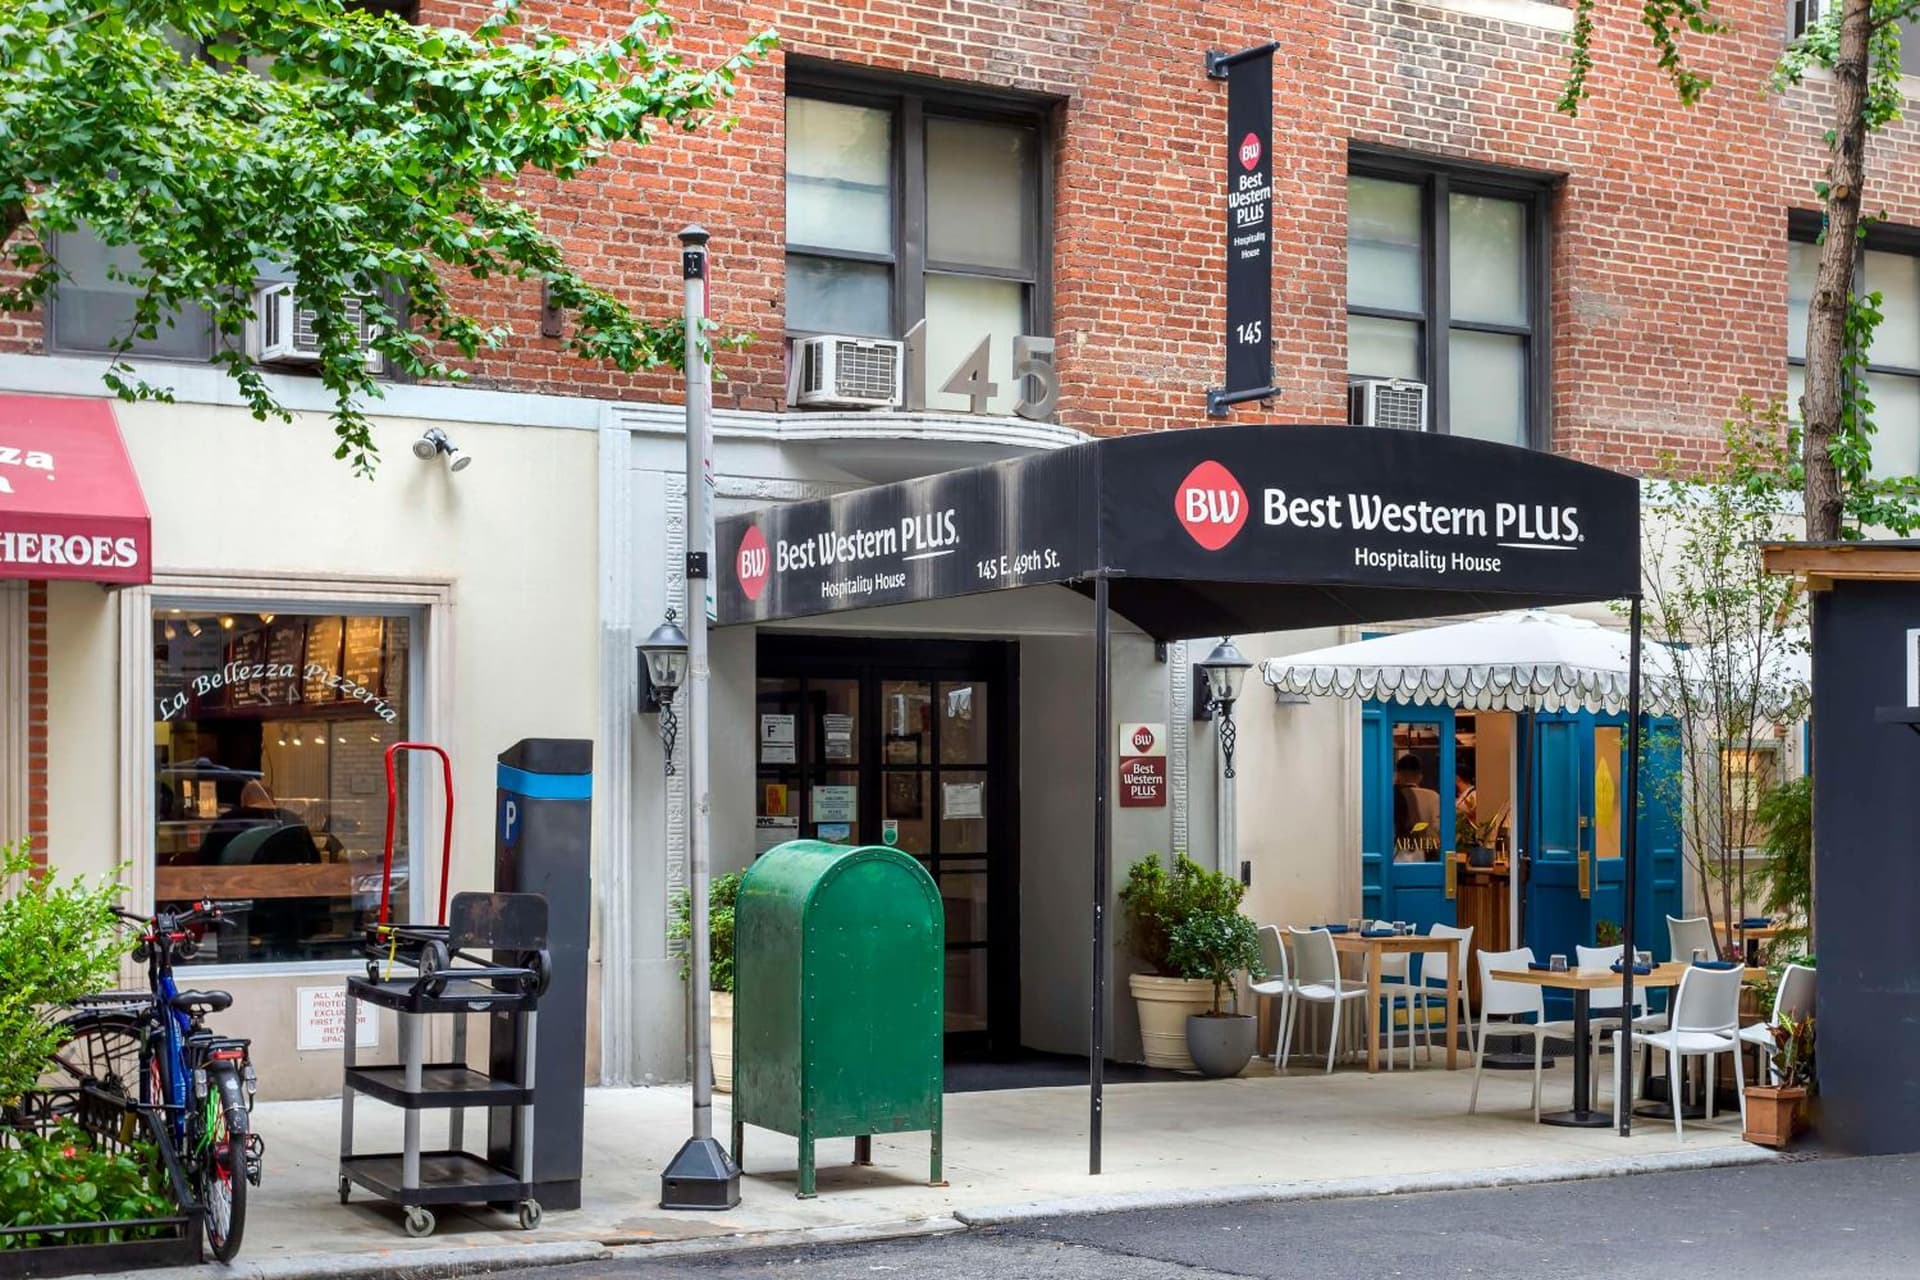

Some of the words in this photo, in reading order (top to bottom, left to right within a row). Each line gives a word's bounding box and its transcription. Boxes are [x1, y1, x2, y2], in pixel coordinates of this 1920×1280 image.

[1242, 143, 1259, 160] BW
[1240, 172, 1262, 191] Best
[1229, 186, 1271, 208] Western
[1237, 203, 1264, 224] PLUS
[1234, 232, 1266, 246] Hospitality
[1241, 248, 1260, 260] House
[1236, 320, 1262, 344] 145
[903, 318, 1060, 420] 145
[1185, 488, 1240, 524] BW
[1263, 488, 1343, 529] Best
[1347, 493, 1488, 537] Western
[776, 538, 816, 572] Best
[818, 527, 897, 566] Western
[1355, 547, 1446, 574] Hospitality
[1451, 552, 1502, 572] House
[741, 548, 766, 579] BW
[976, 559, 998, 579] 145
[1000, 555, 1011, 576] E.
[1013, 550, 1041, 575] 49th
[1044, 548, 1061, 568] St.
[821, 575, 873, 599] Hospitality
[875, 571, 906, 590] House
[158, 693, 190, 721] La
[191, 660, 296, 697] Bellezza
[303, 662, 398, 724] Pizzeria
[768, 725, 777, 738] F
[1134, 734, 1152, 746] BW
[1124, 774, 1163, 784] Western
[1133, 763, 1155, 774] Best
[1131, 785, 1157, 796] PLUS
[505, 800, 517, 840] P
